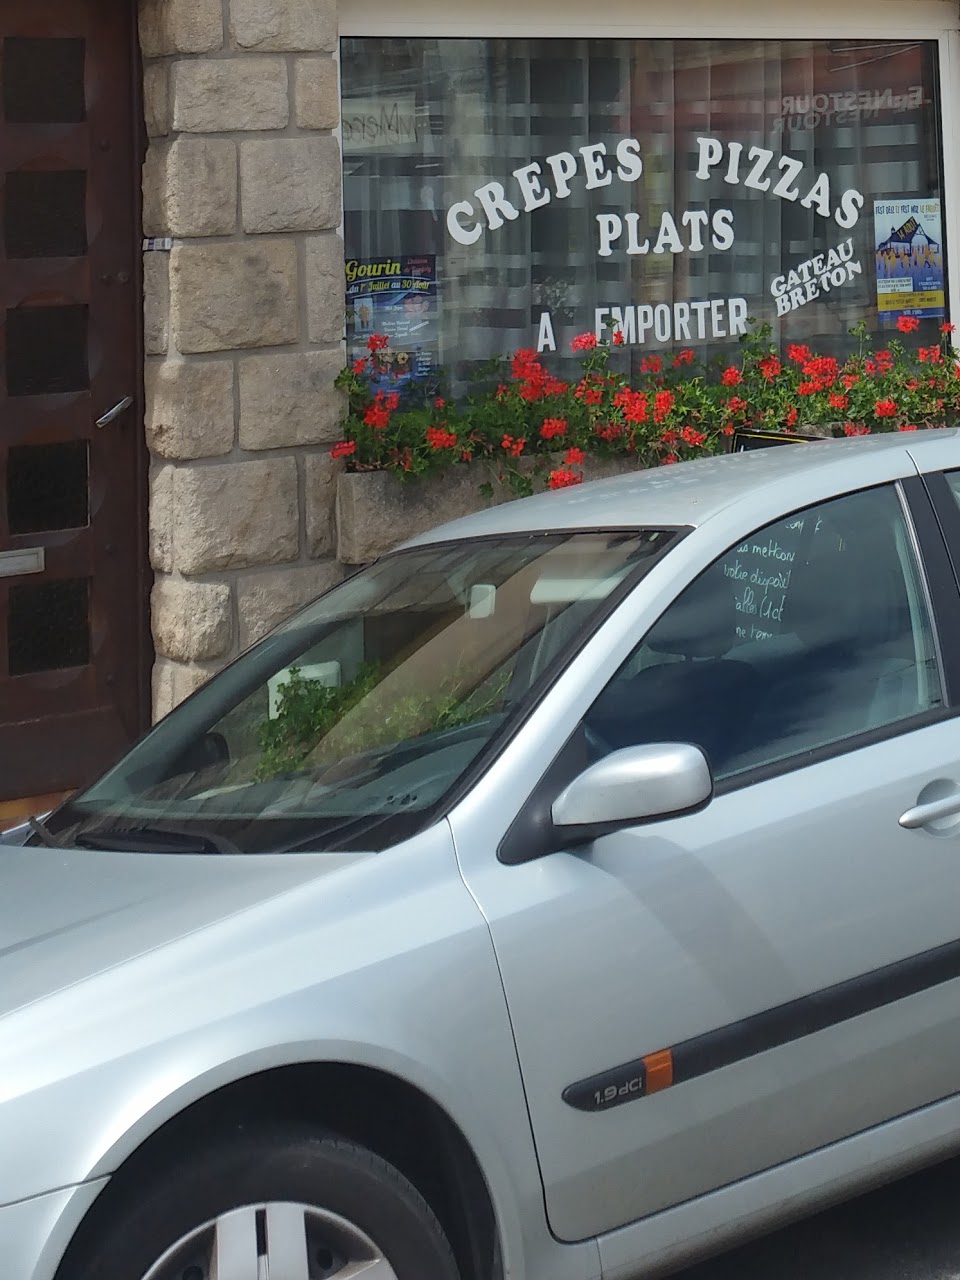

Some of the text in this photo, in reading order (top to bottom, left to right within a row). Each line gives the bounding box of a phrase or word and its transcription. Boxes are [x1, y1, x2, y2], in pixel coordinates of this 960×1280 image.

[446, 136, 865, 246] CREPES PIZZAS
[595, 208, 735, 257] PLATS
[345, 258, 401, 282] Gourin
[349, 284, 360, 293] du
[368, 280, 391, 293] Juillet
[391, 281, 401, 289] au
[402, 279, 412, 289] 30
[770, 238, 854, 298] GATEAU
[774, 260, 862, 318] BRETON
[536, 297, 749, 353] A EMPORTER
